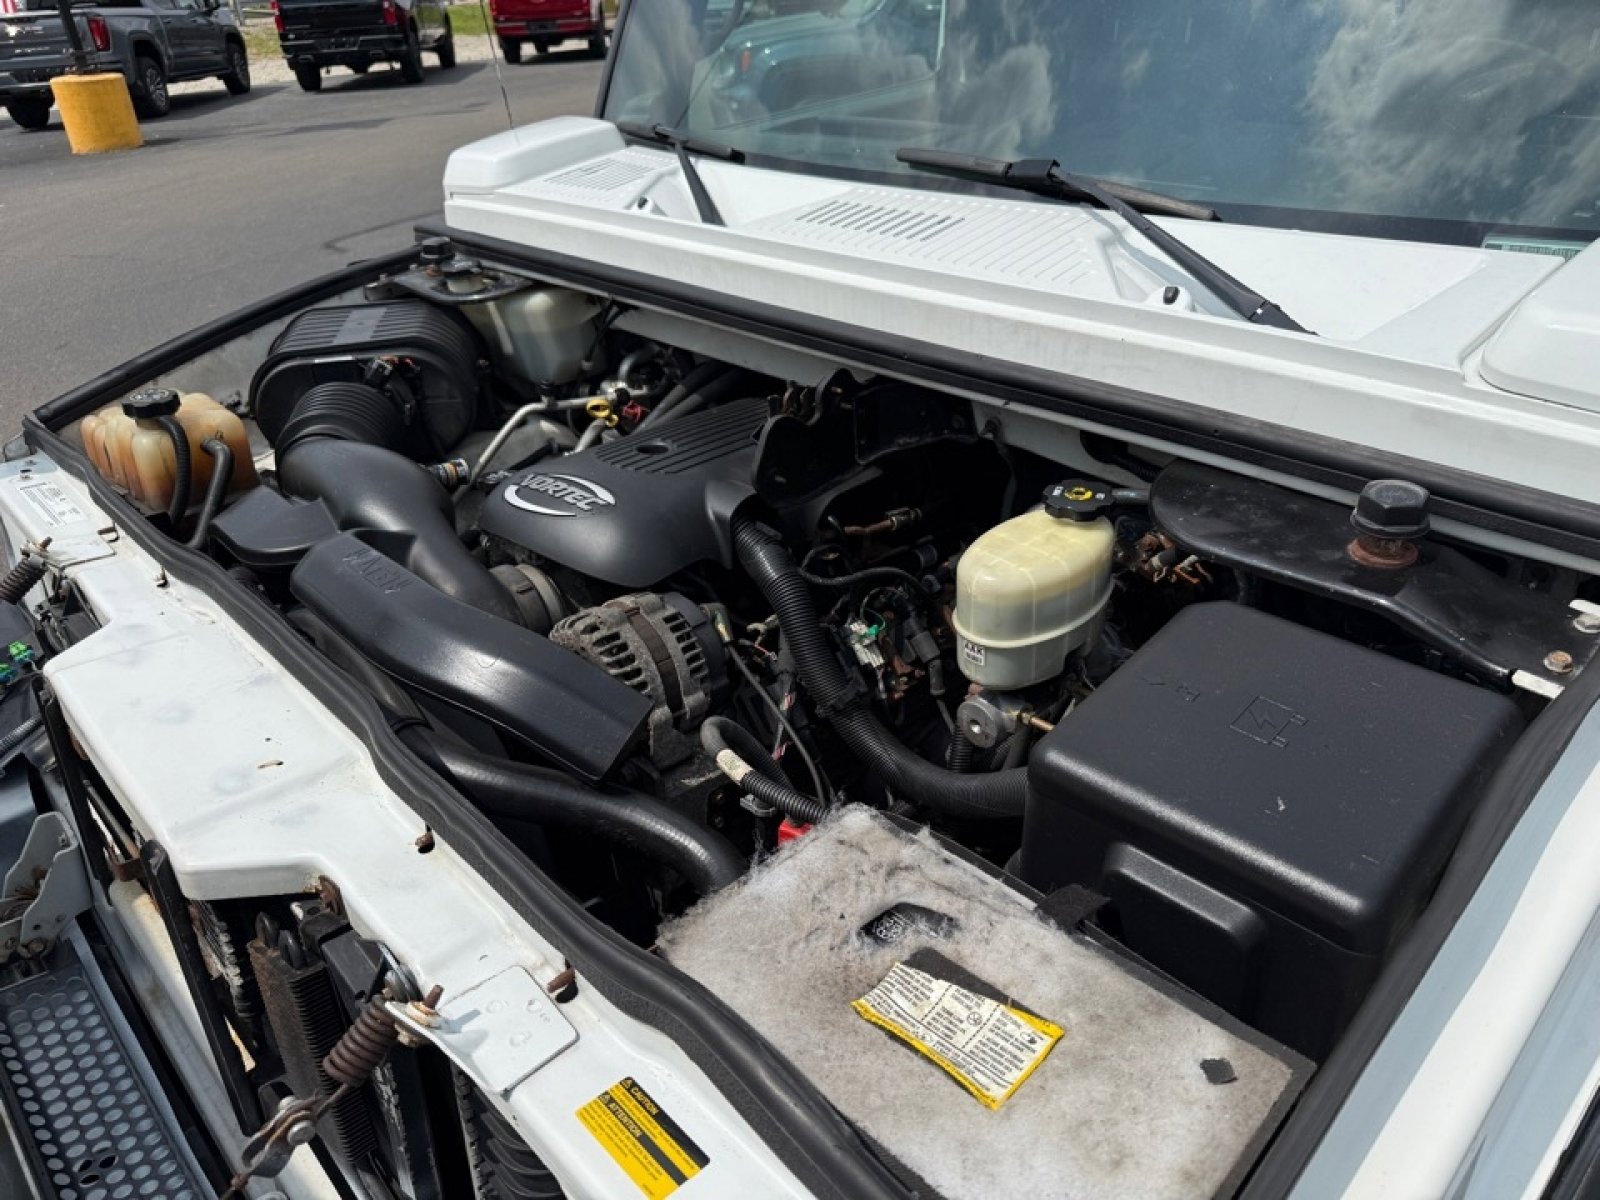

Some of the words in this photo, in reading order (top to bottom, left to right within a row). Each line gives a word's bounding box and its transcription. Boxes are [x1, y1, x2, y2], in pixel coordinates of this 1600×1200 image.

[519, 473, 608, 512] VORTEC
[630, 1086, 660, 1116] CAUTION
[608, 1102, 643, 1138] ATTENTION
